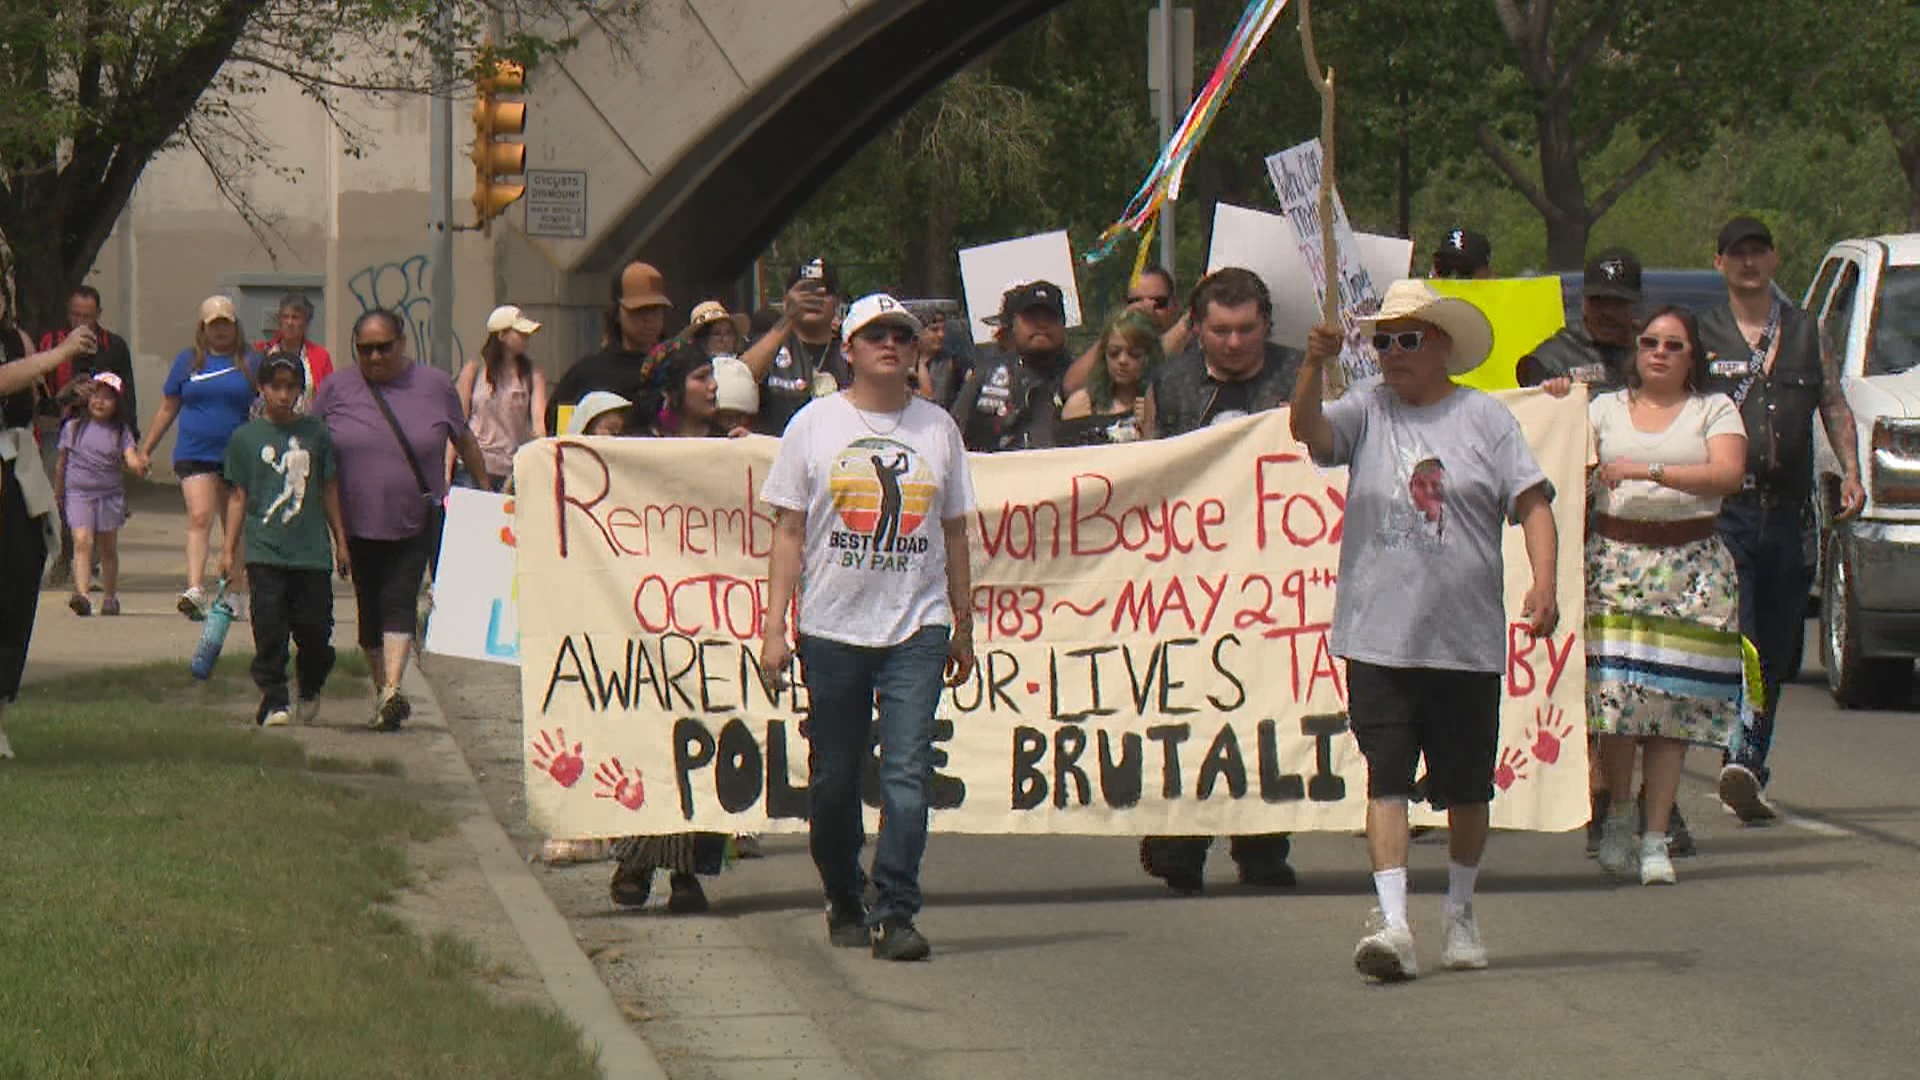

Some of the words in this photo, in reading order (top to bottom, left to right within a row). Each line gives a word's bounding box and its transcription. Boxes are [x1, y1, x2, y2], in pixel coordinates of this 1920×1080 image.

[534, 175, 579, 186] CYCLISTS
[554, 441, 776, 558] Rememb
[978, 500, 1060, 561] von
[1071, 473, 1227, 562] Boyce
[830, 531, 872, 551] BEST
[896, 536, 928, 553] DAD
[841, 551, 865, 570] BY
[870, 553, 908, 572] PAR
[972, 584, 1045, 642] 983
[1111, 574, 1229, 635] MAY
[1050, 633, 1246, 722] LIVES
[1509, 623, 1575, 698] BY
[1010, 712, 1351, 811] BRUTALI
